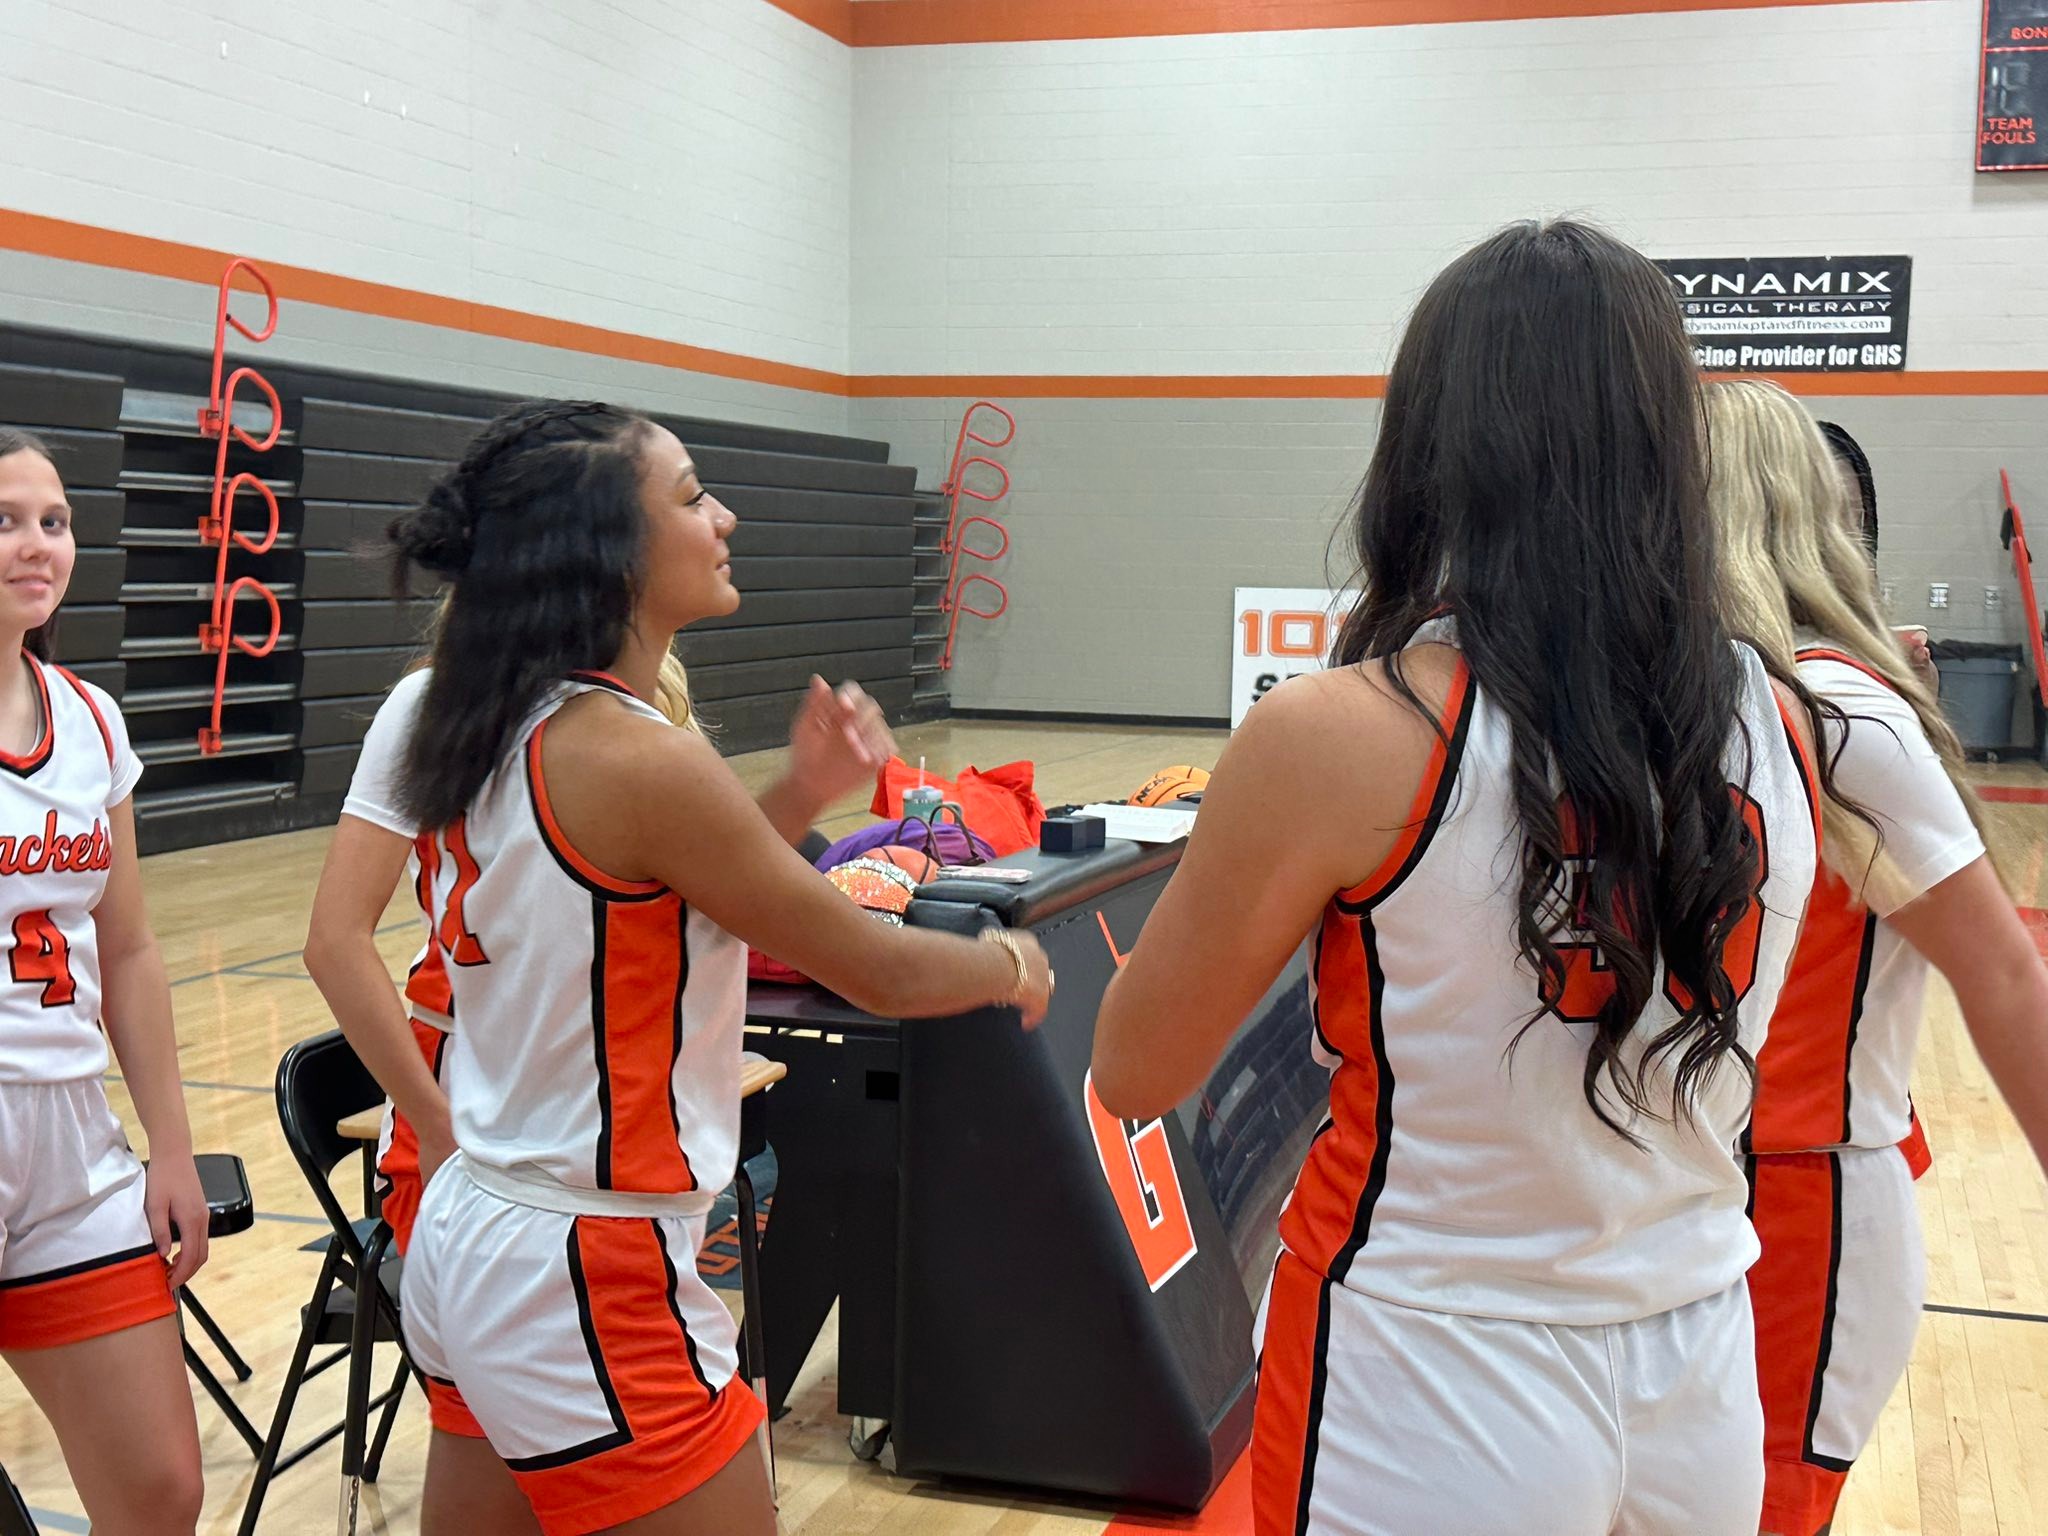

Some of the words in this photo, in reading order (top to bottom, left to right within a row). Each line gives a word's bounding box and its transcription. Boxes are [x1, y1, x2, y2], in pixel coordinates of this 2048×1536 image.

[1987, 117, 2033, 131] TEAM
[1982, 131, 2036, 145] FOULS
[1673, 271, 1892, 295] YNAMIX
[1680, 302, 1760, 314] SICAL
[1772, 301, 1892, 313] THERAPY
[1691, 345, 1737, 366] cine
[1740, 344, 1826, 367] Provider
[1828, 344, 1858, 366] for
[1861, 344, 1902, 366] GHS
[1252, 672, 1305, 703] S
[8, 909, 77, 1009] 4
